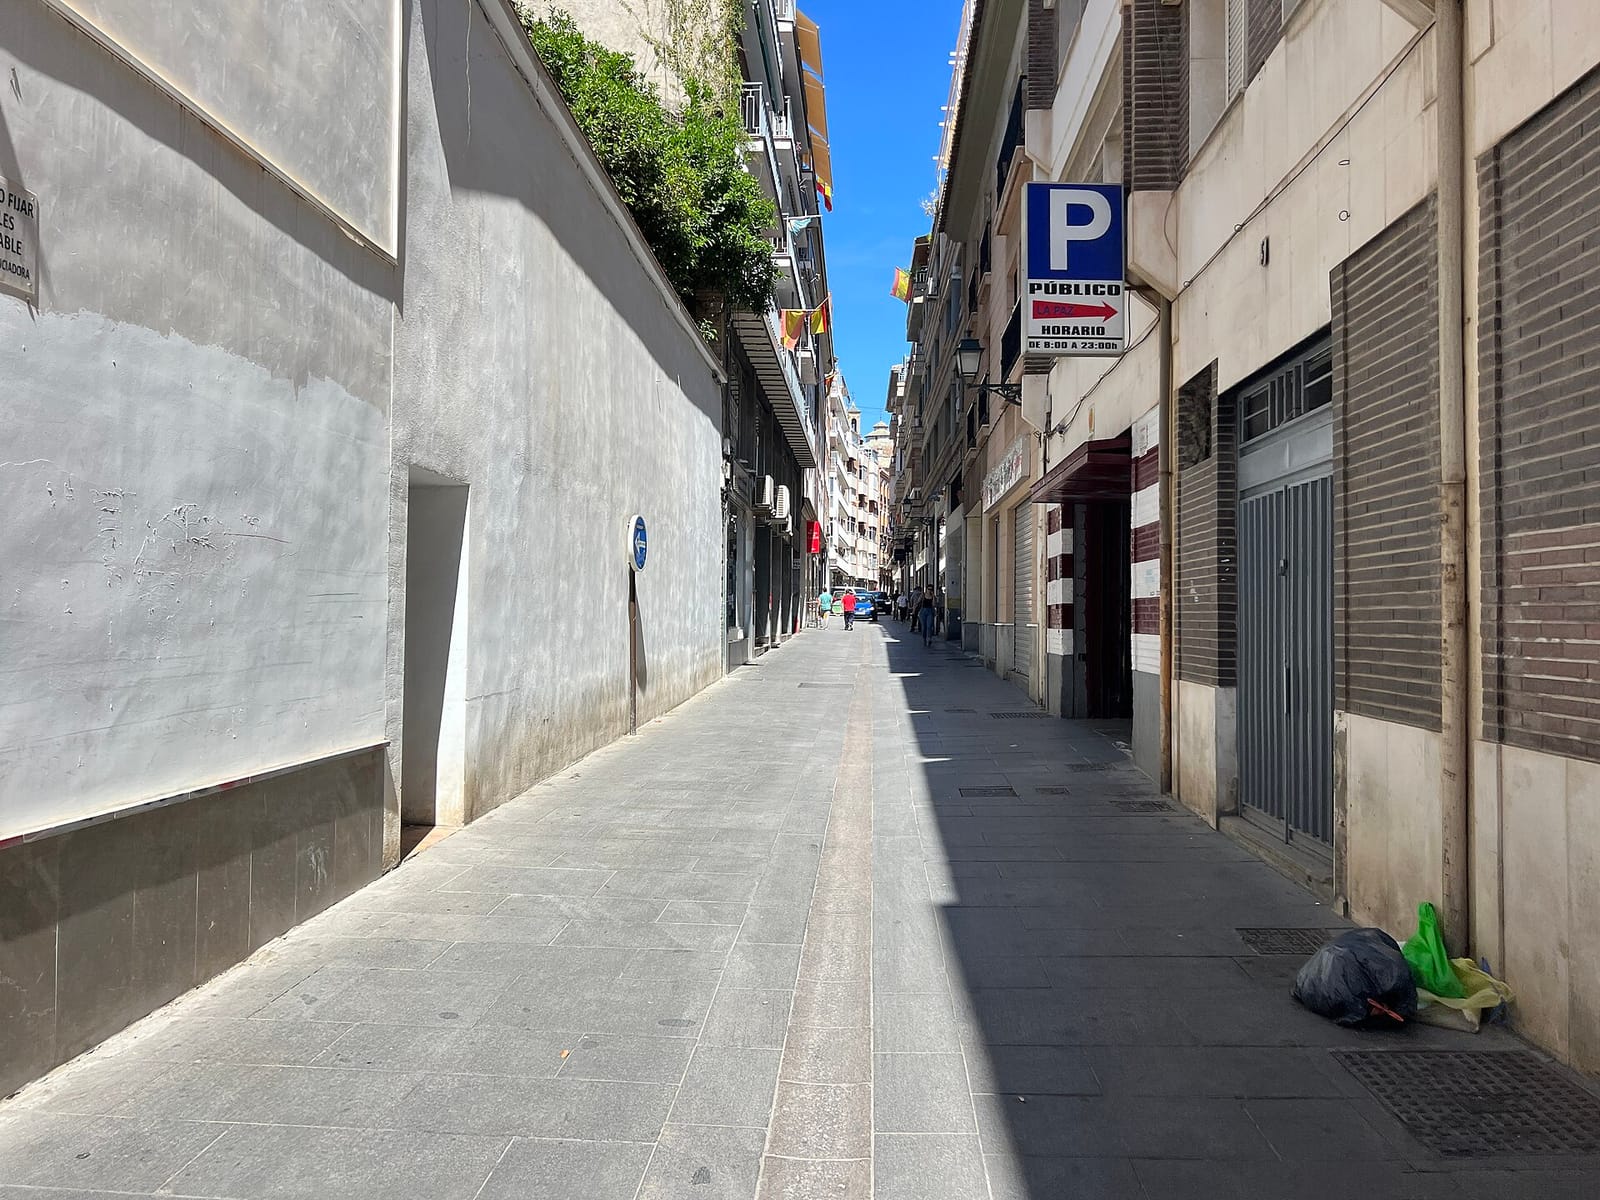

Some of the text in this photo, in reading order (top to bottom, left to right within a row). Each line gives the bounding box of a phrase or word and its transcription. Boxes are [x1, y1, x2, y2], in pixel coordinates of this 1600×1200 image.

[8, 192, 34, 219] FIJAR
[0, 212, 15, 231] ES
[1049, 188, 1112, 271] P
[1029, 281, 1121, 297] PÚBLICO
[1036, 305, 1075, 316] LA PAZ
[1041, 325, 1106, 336] HORARIO
[1028, 341, 1118, 350] DE 8:00 A 23:00h
